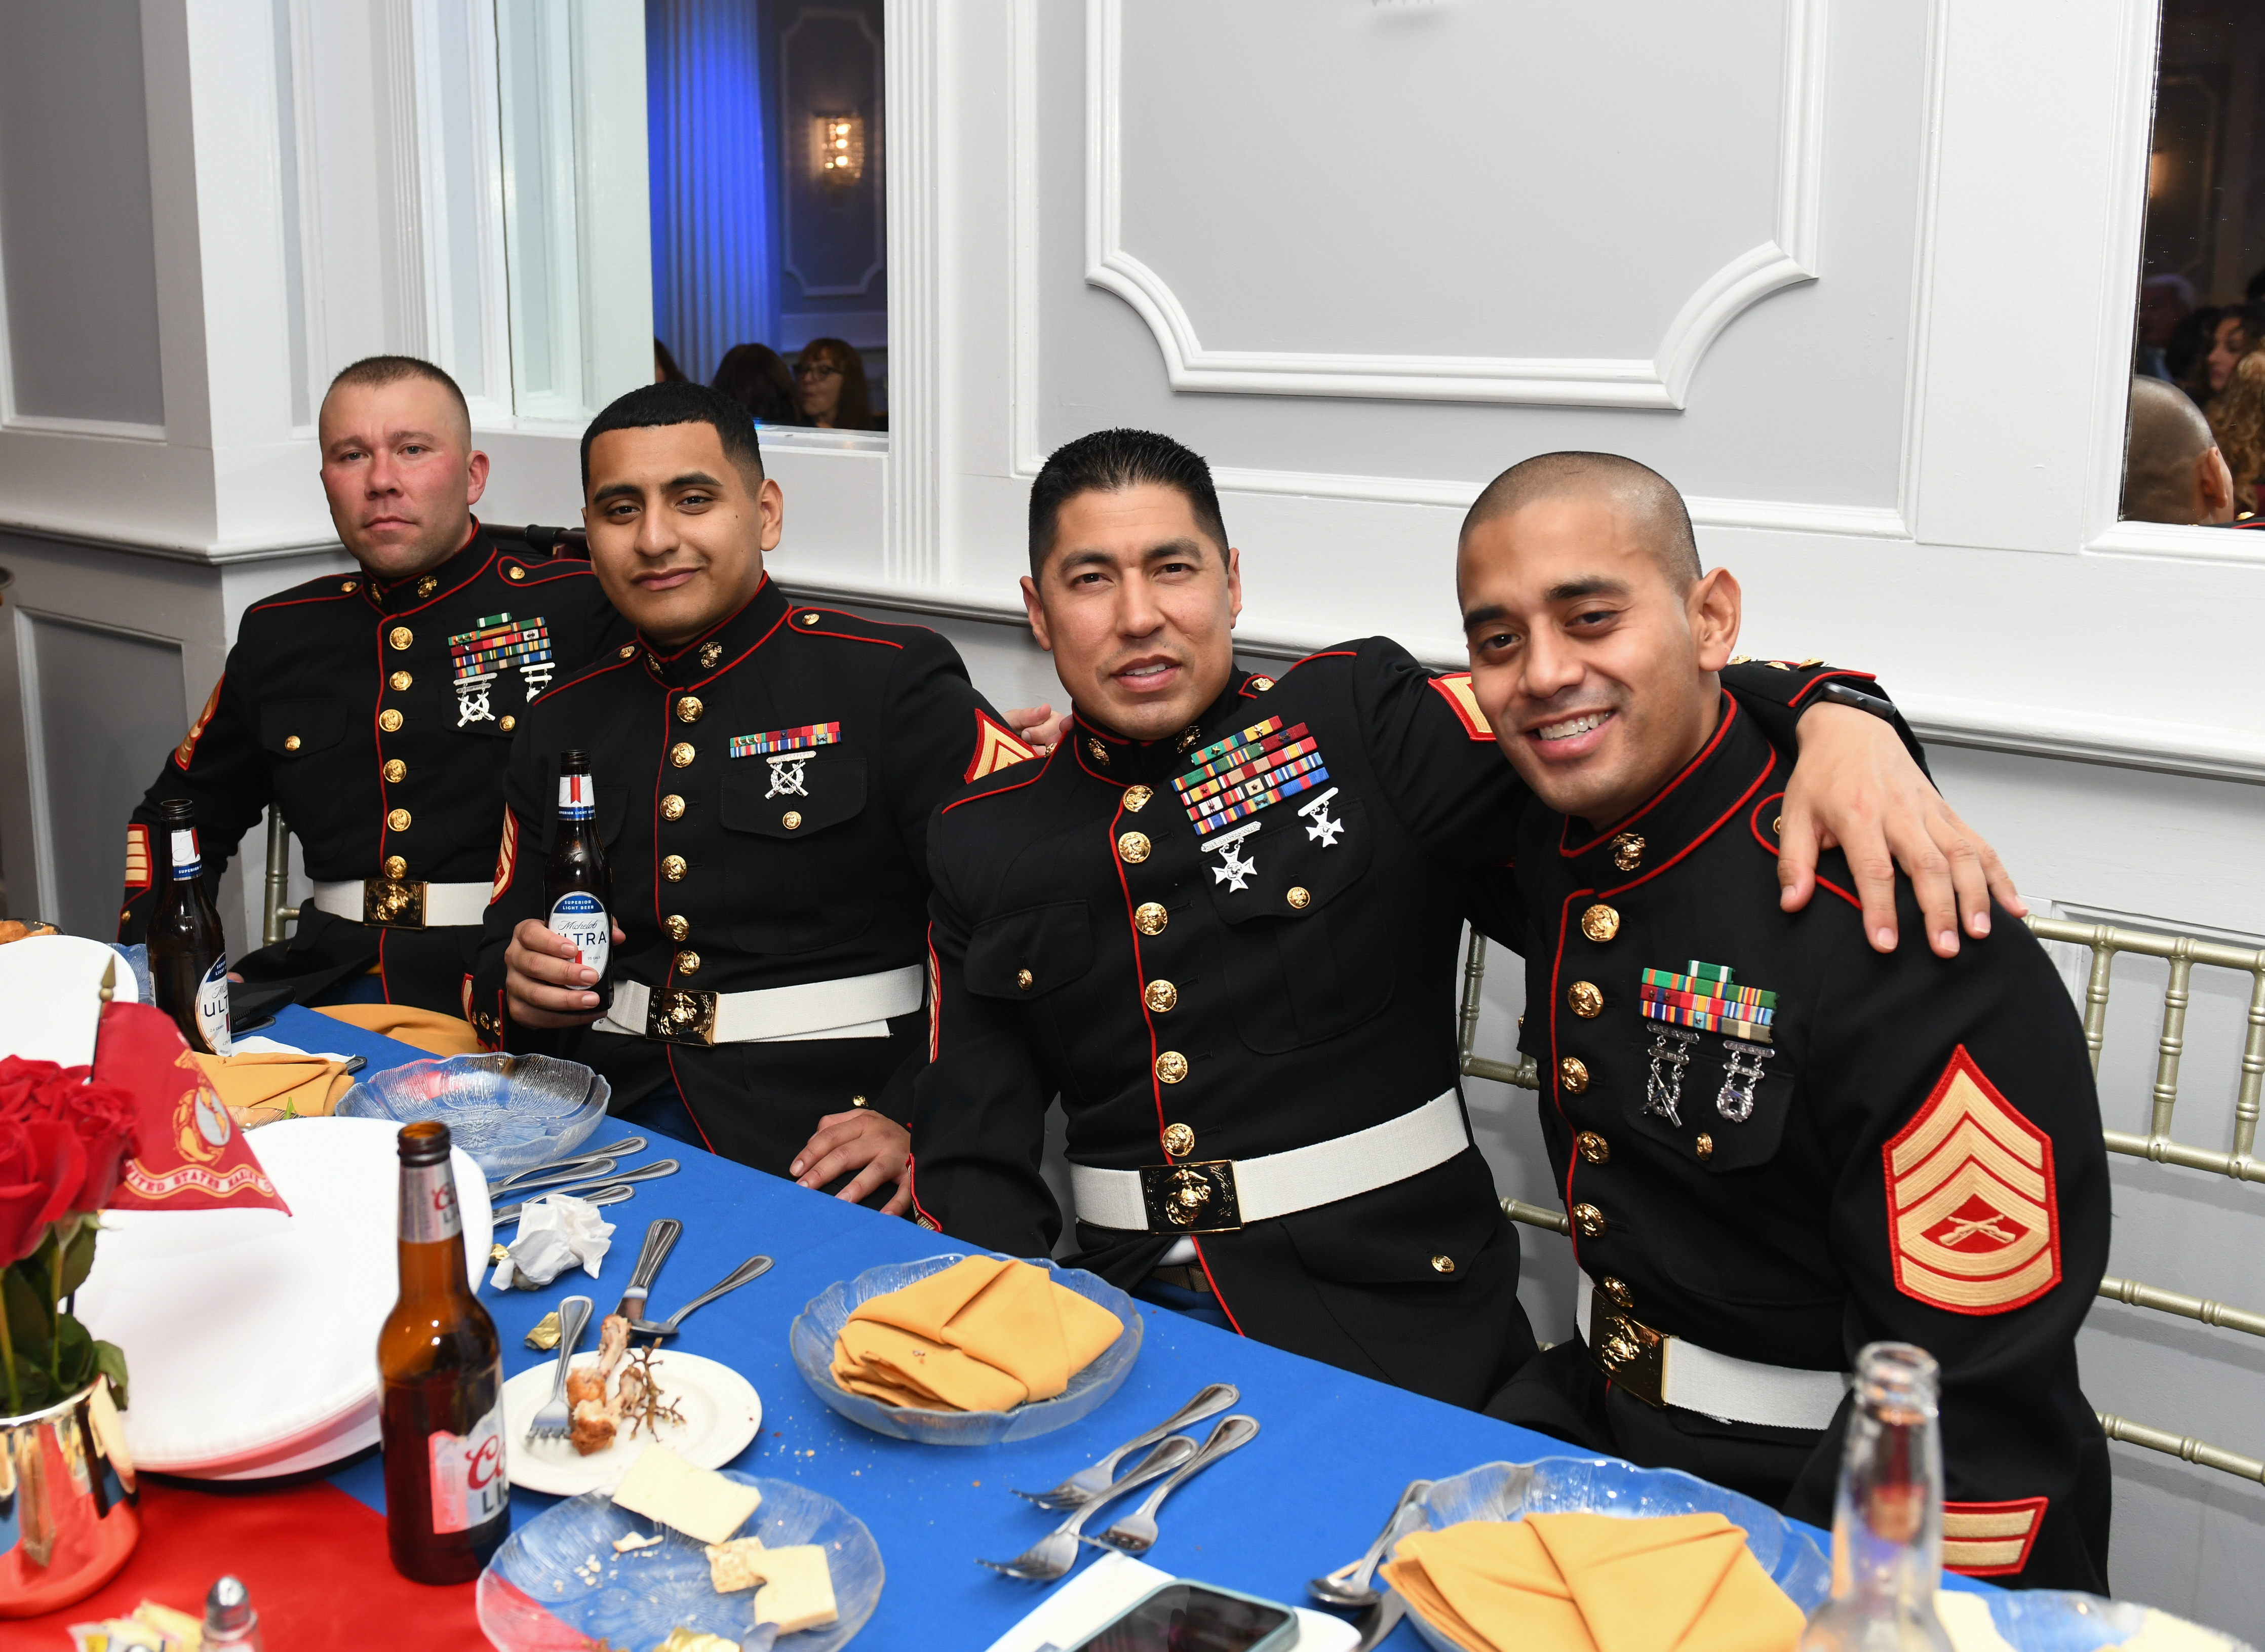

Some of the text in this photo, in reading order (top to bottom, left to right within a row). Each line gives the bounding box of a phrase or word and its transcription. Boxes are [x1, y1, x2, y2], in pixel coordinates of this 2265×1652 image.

[178, 866, 200, 874] SUPERIOR
[558, 919, 599, 930] Michelob
[558, 931, 607, 946] TRA
[204, 994, 228, 1017] ULT
[126, 1165, 165, 1192] NITED
